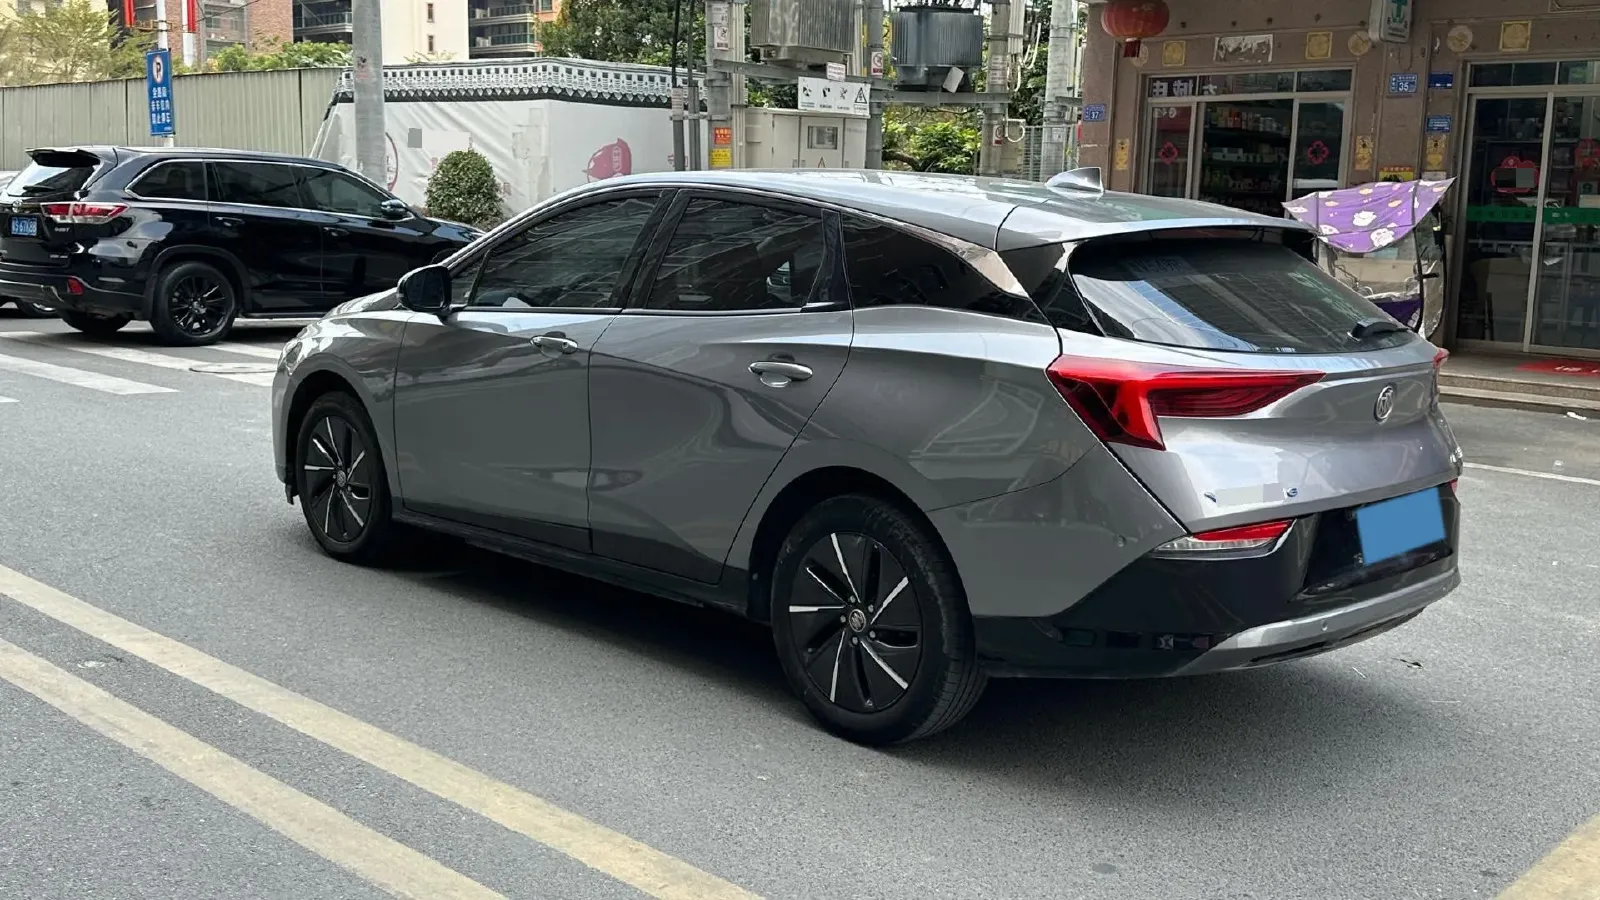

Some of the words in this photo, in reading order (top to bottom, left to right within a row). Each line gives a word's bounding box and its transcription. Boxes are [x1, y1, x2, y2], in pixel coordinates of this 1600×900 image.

[155, 61, 162, 79] P
[1397, 81, 1409, 92] 35
[151, 112, 171, 124] 禁止停车
[1091, 111, 1100, 119] 37
